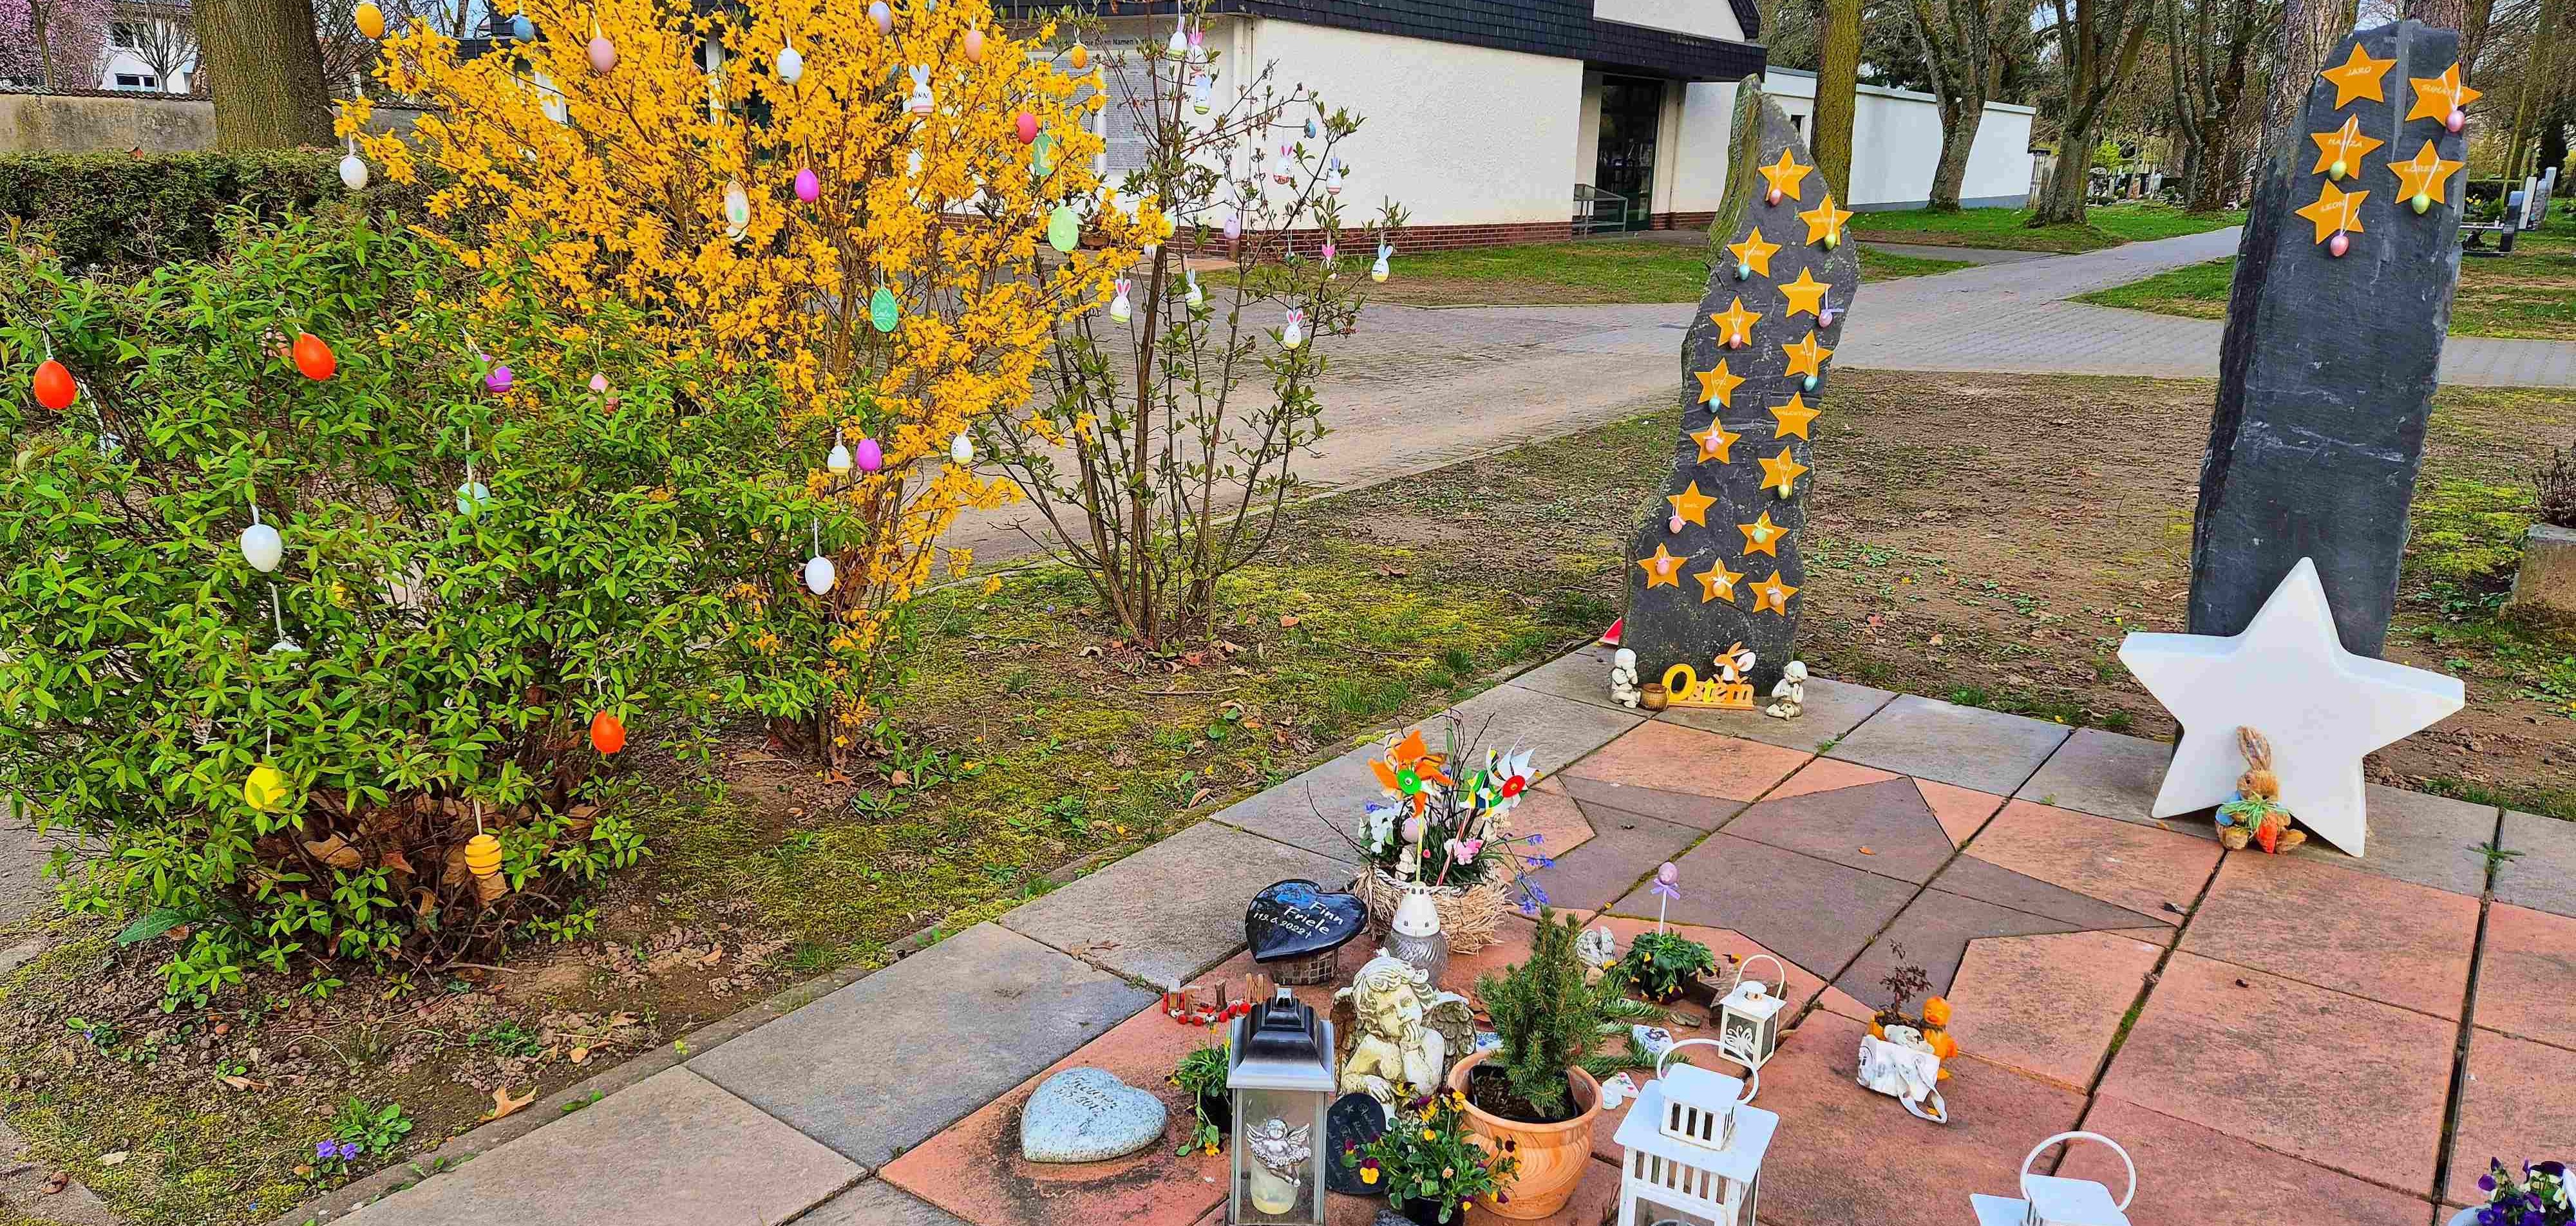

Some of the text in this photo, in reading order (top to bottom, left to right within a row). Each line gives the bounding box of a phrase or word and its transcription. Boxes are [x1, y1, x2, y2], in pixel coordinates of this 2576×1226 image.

[1662, 664, 1754, 703] Ostern
[1283, 906, 1330, 936] Friele
[1309, 901, 1343, 925] Finn
